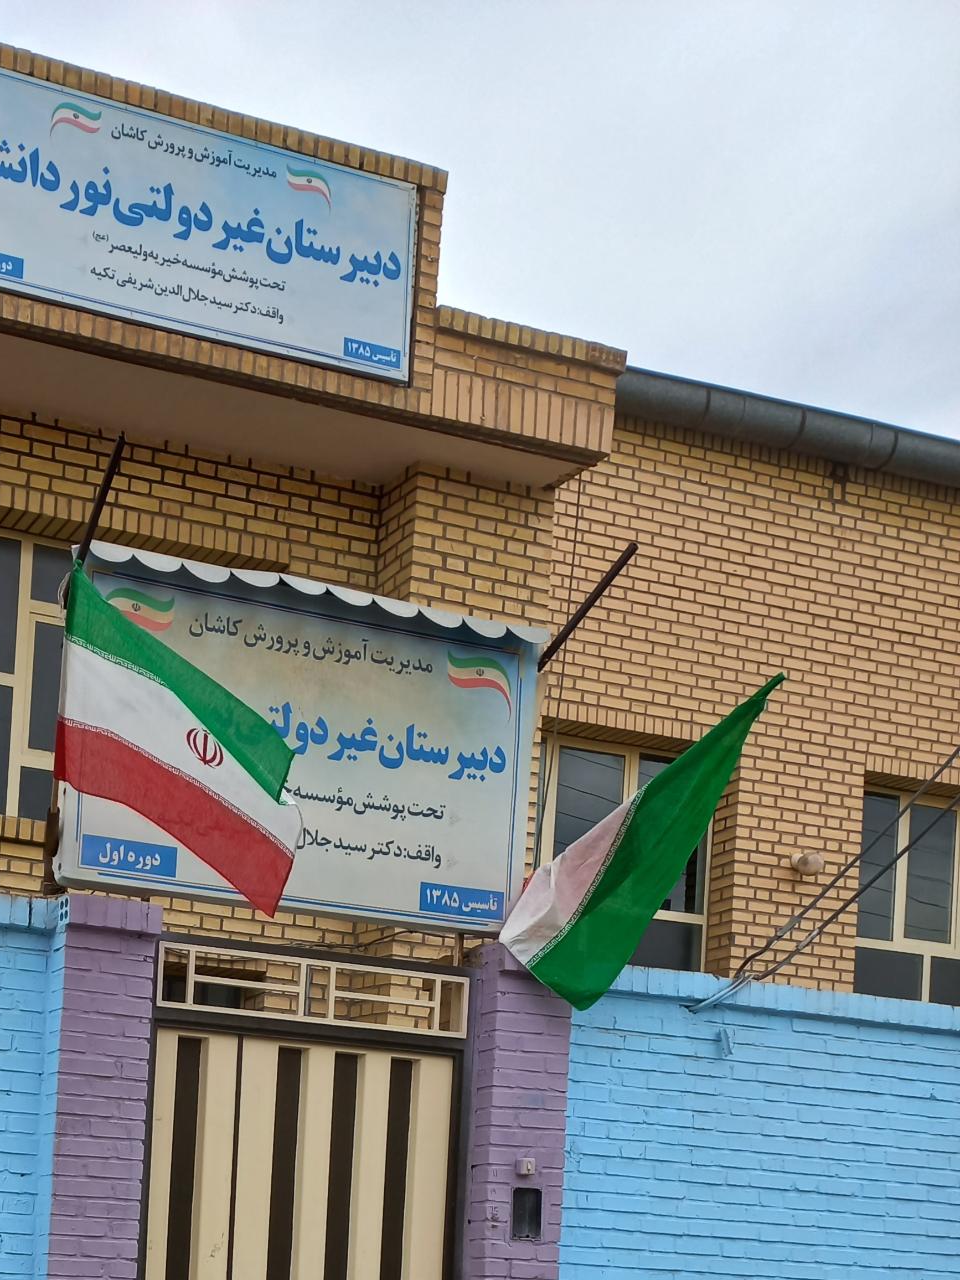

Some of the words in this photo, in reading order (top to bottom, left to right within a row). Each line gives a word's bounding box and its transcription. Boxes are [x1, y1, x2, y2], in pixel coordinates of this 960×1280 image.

[111, 124, 147, 141] کاشان
[148, 134, 186, 158] پرورش
[187, 147, 194, 159] و
[194, 146, 232, 167] آموزش
[234, 157, 277, 178] مدیریت
[148, 250, 182, 267] خیریه
[266, 218, 401, 287] دبیرستان
[90, 266, 117, 281] تکیه
[116, 273, 154, 291] شریفی
[223, 268, 260, 290] پوشش
[259, 276, 286, 291] تحت
[210, 297, 233, 309] سید
[233, 301, 257, 314] دکتر
[347, 341, 371, 357] ۱۳۸۵
[189, 612, 243, 637] کاشان
[243, 624, 299, 656] پرورش
[302, 641, 311, 657] و
[312, 637, 368, 665] آموزش
[370, 647, 433, 674] مدیریت
[378, 723, 507, 782] دبیرستان
[293, 785, 353, 811] مؤسسه
[353, 792, 406, 821] پوشش
[407, 801, 446, 820] تحت
[98, 842, 124, 865] اول
[333, 837, 367, 856] سید
[367, 841, 403, 860] دکتر
[127, 851, 161, 870] دوره
[426, 887, 460, 908] ۱۳۸۵
